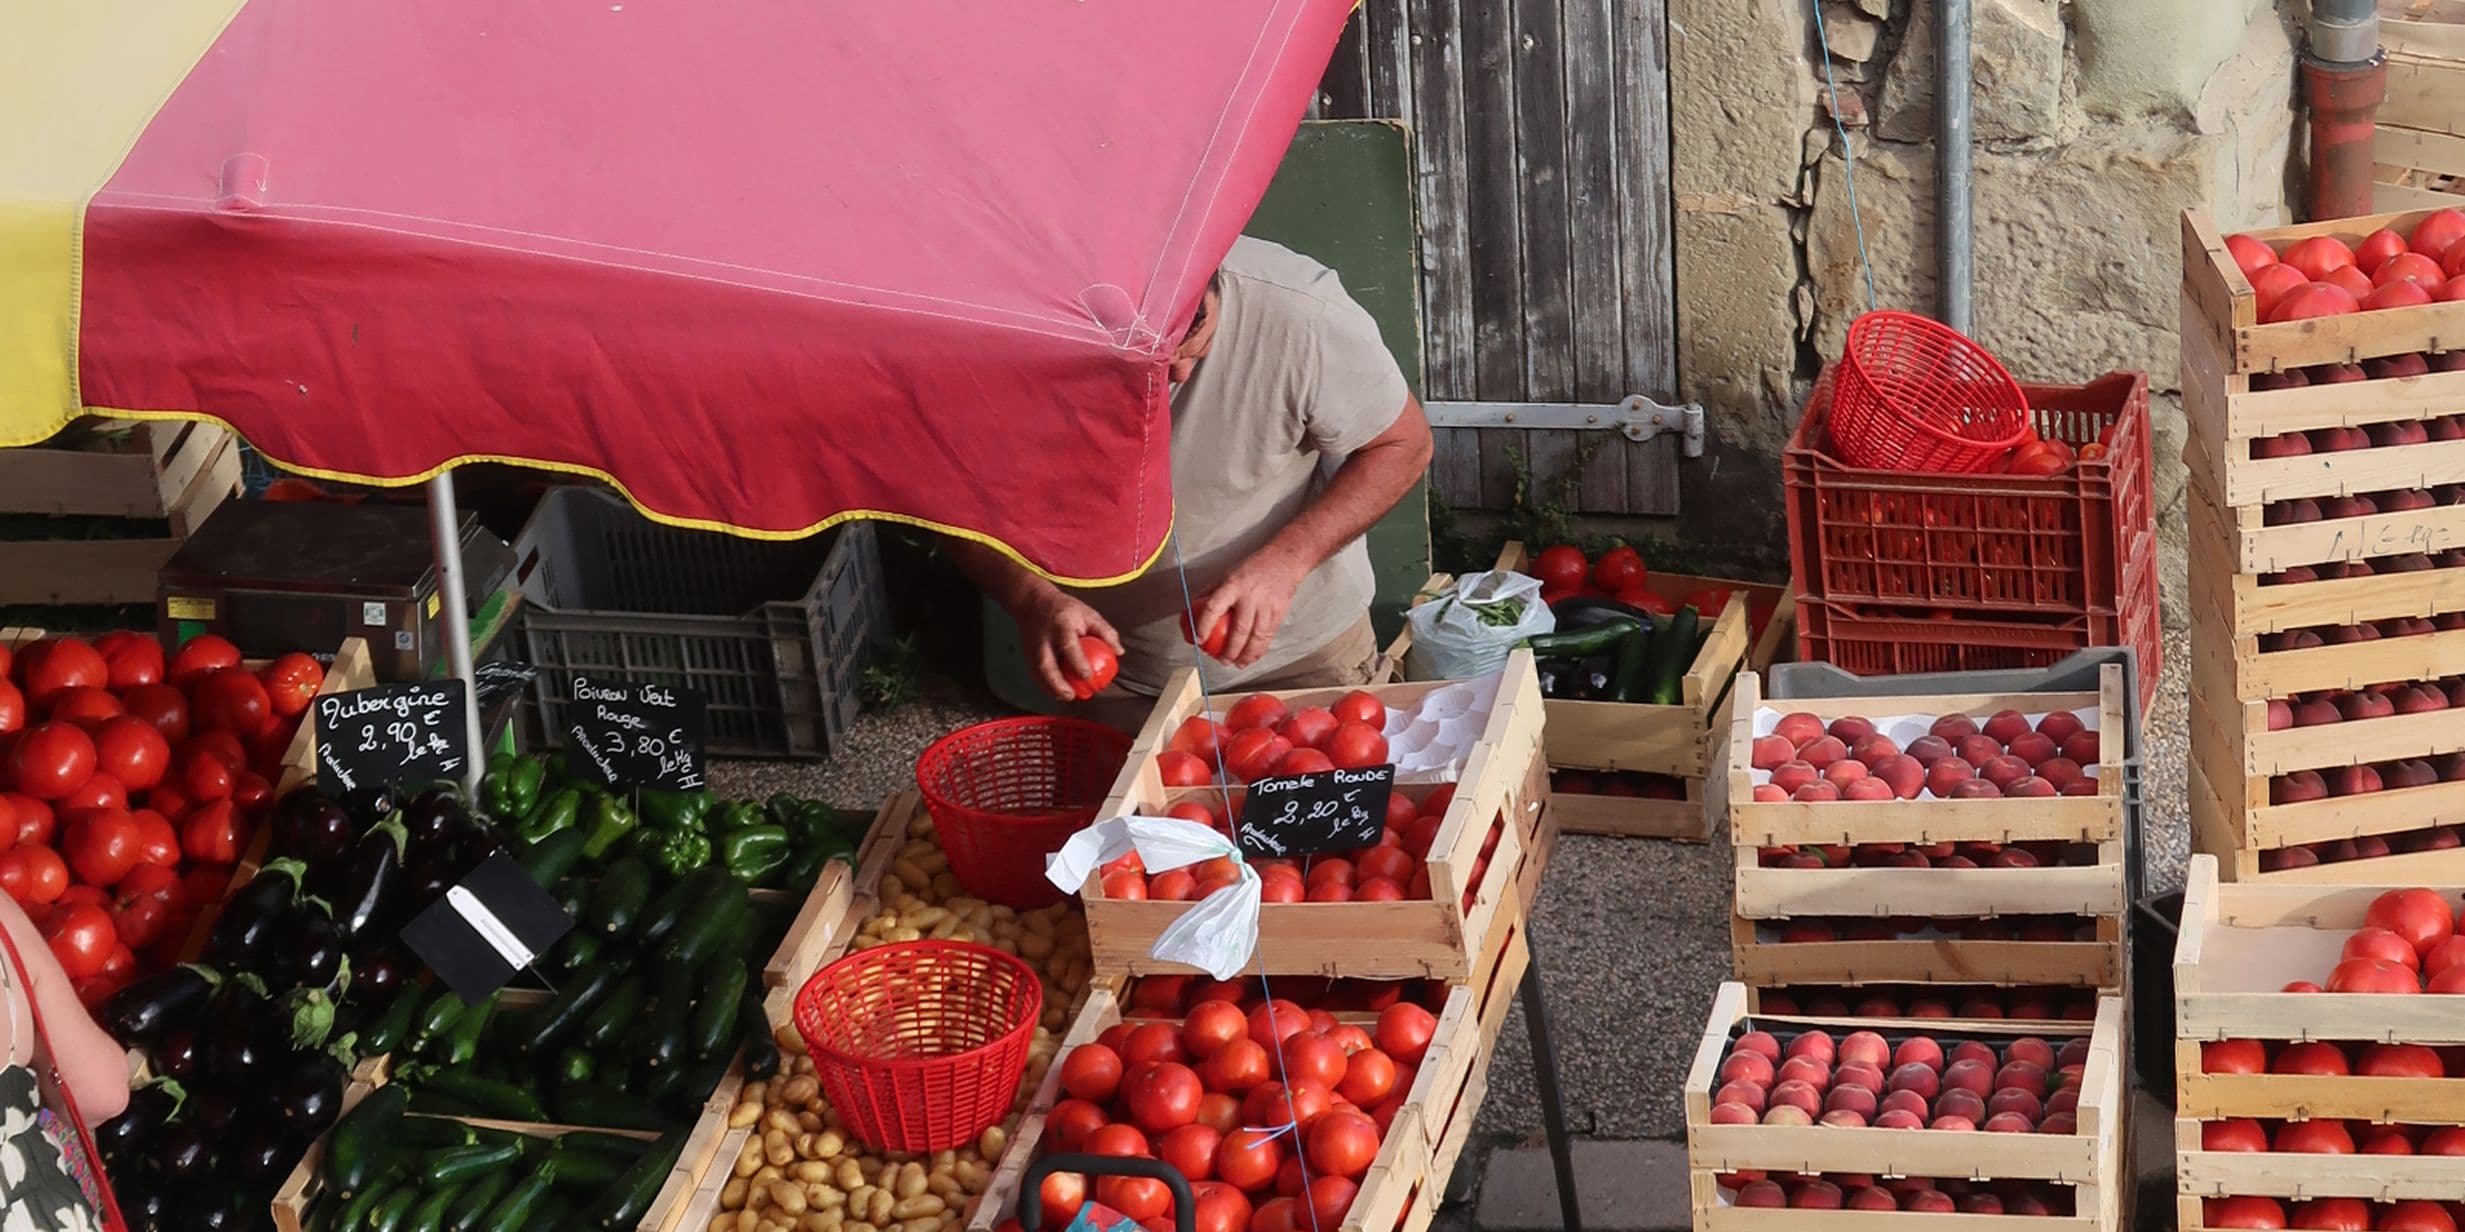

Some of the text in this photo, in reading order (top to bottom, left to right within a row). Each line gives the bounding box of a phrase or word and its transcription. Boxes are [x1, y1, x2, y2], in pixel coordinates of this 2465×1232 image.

[321, 686, 449, 729] Aubergine
[597, 704, 646, 729] Rouge
[358, 721, 417, 752] 2,90
[604, 731, 665, 757] 3,80
[1251, 775, 1315, 796] Tomate
[1273, 801, 1338, 825] 2,20
